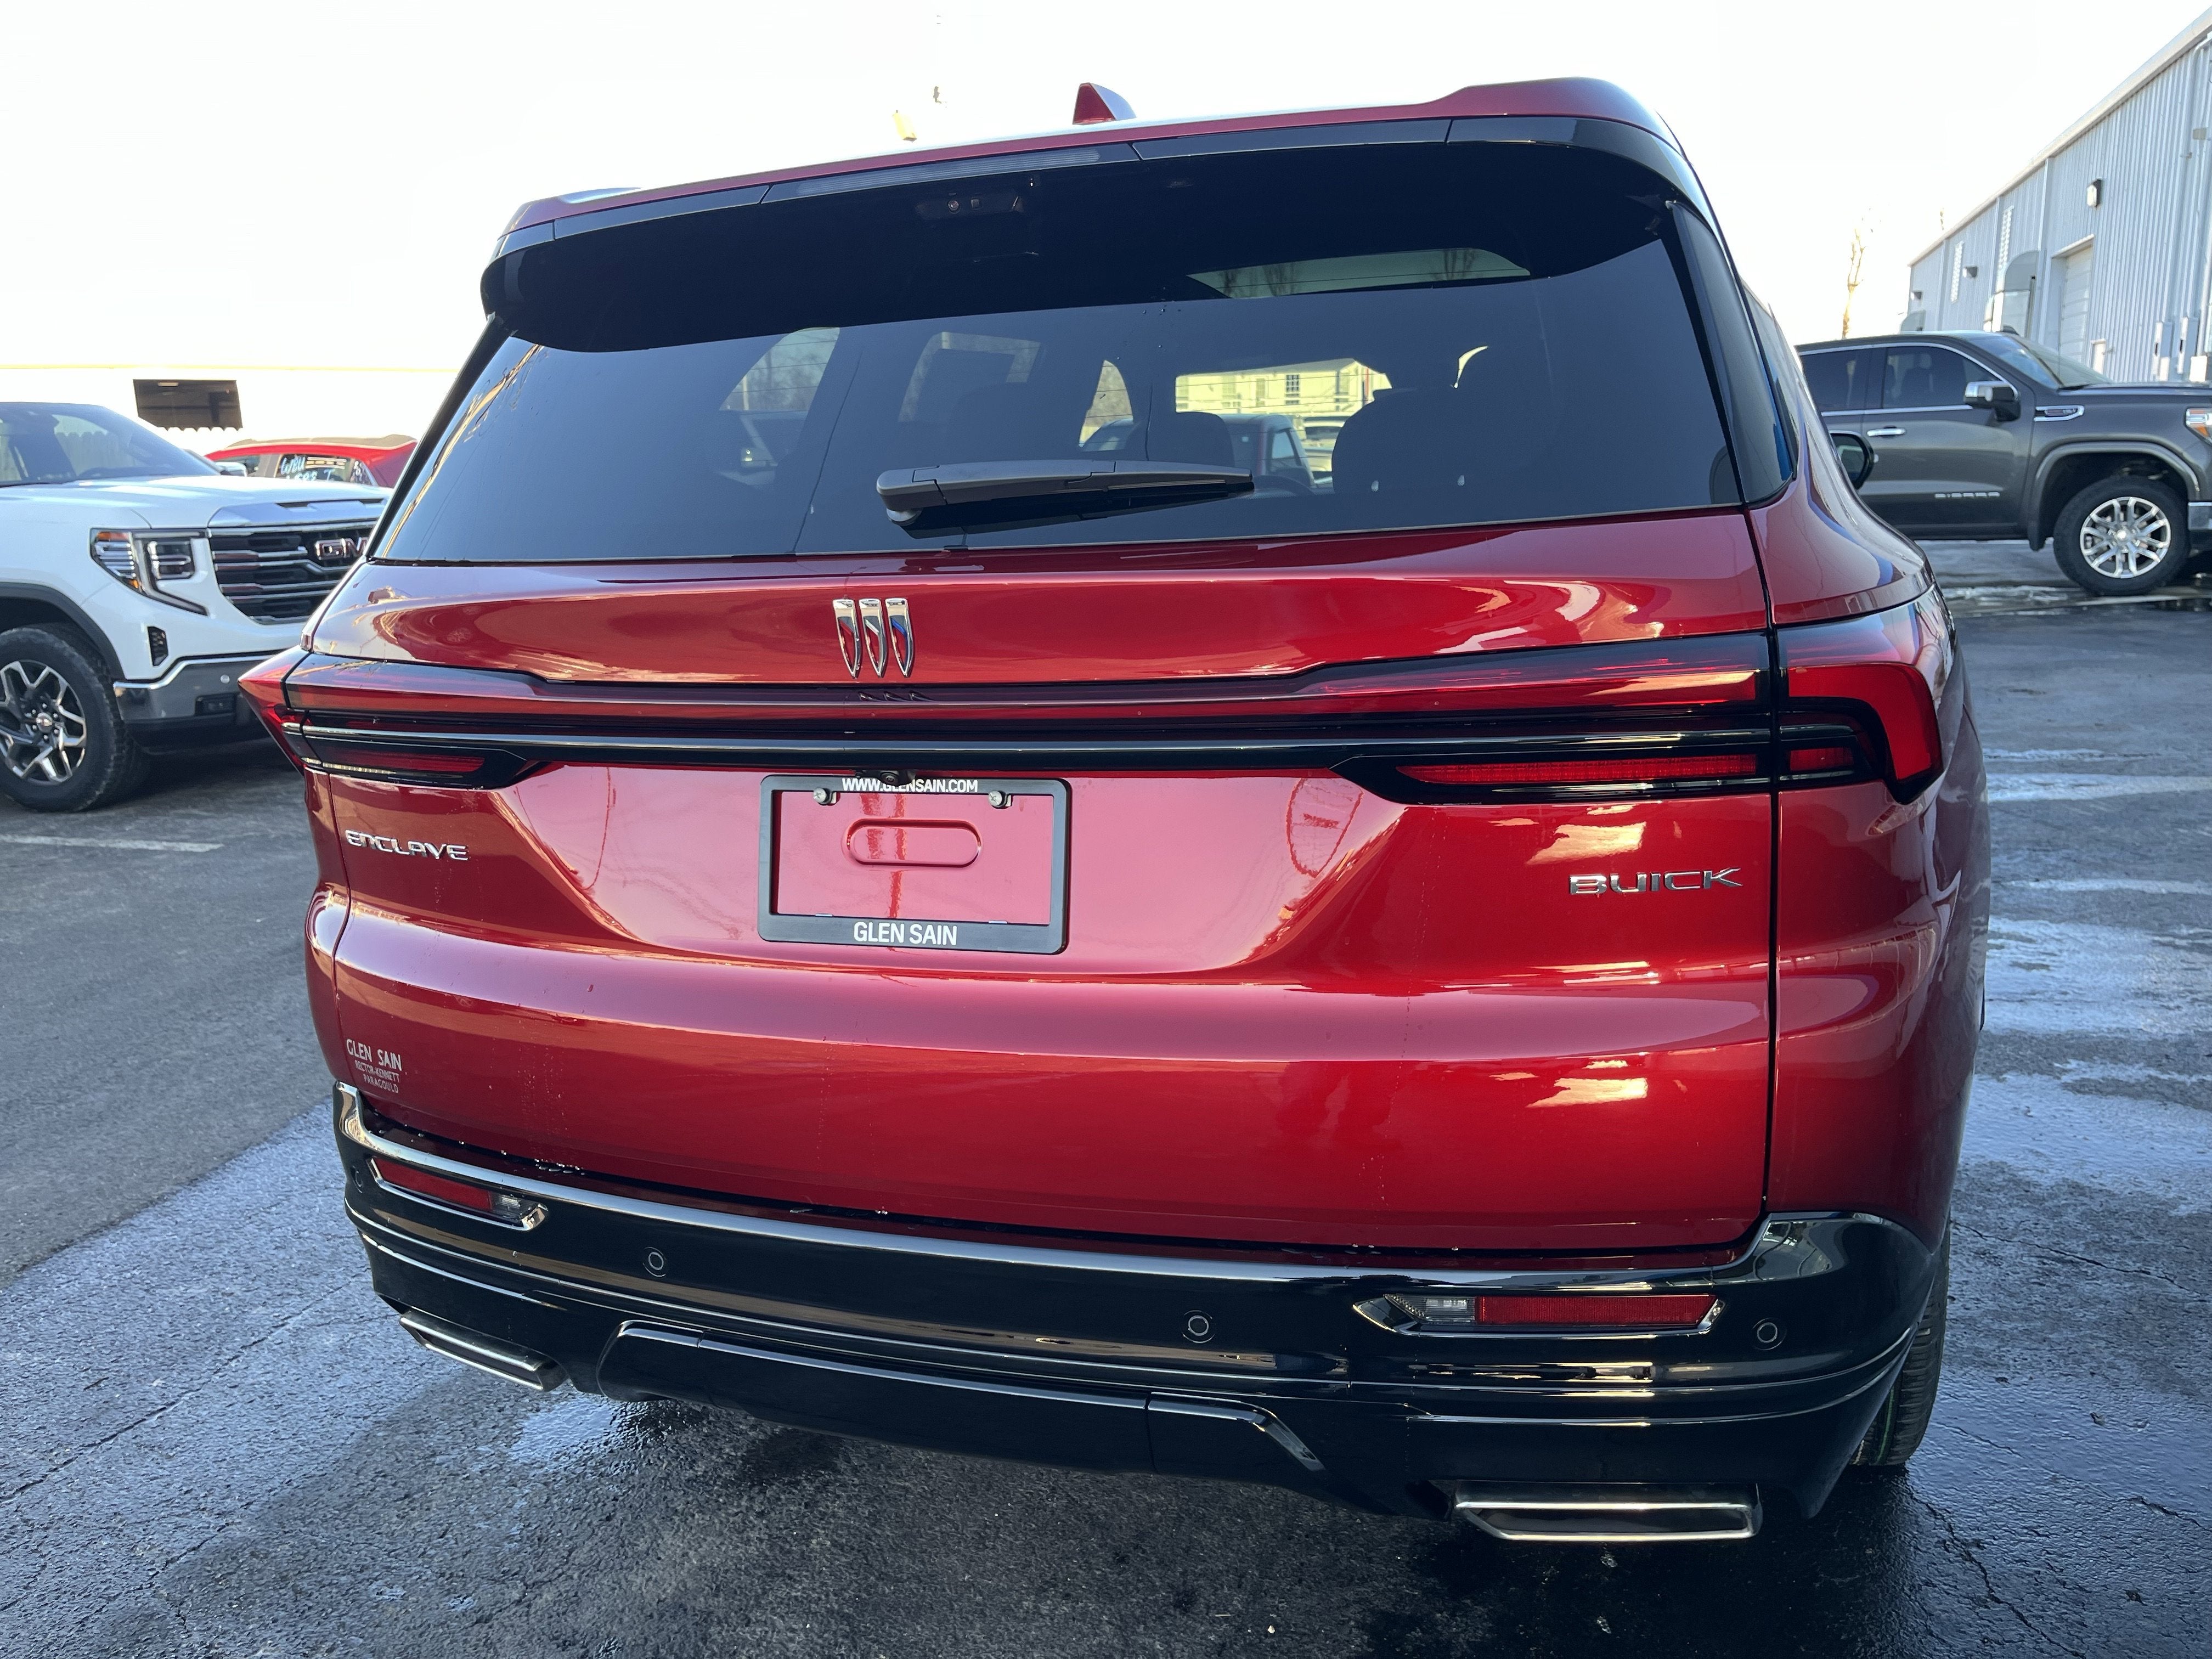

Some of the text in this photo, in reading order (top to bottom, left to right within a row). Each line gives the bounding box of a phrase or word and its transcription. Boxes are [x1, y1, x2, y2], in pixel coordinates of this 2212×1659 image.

[315, 538, 368, 560] GM
[345, 829, 470, 861] ENCLAVE
[1569, 867, 1743, 895] BUICK
[854, 921, 957, 946] GLEN SAIN
[346, 1039, 402, 1071] GLEN SAIN
